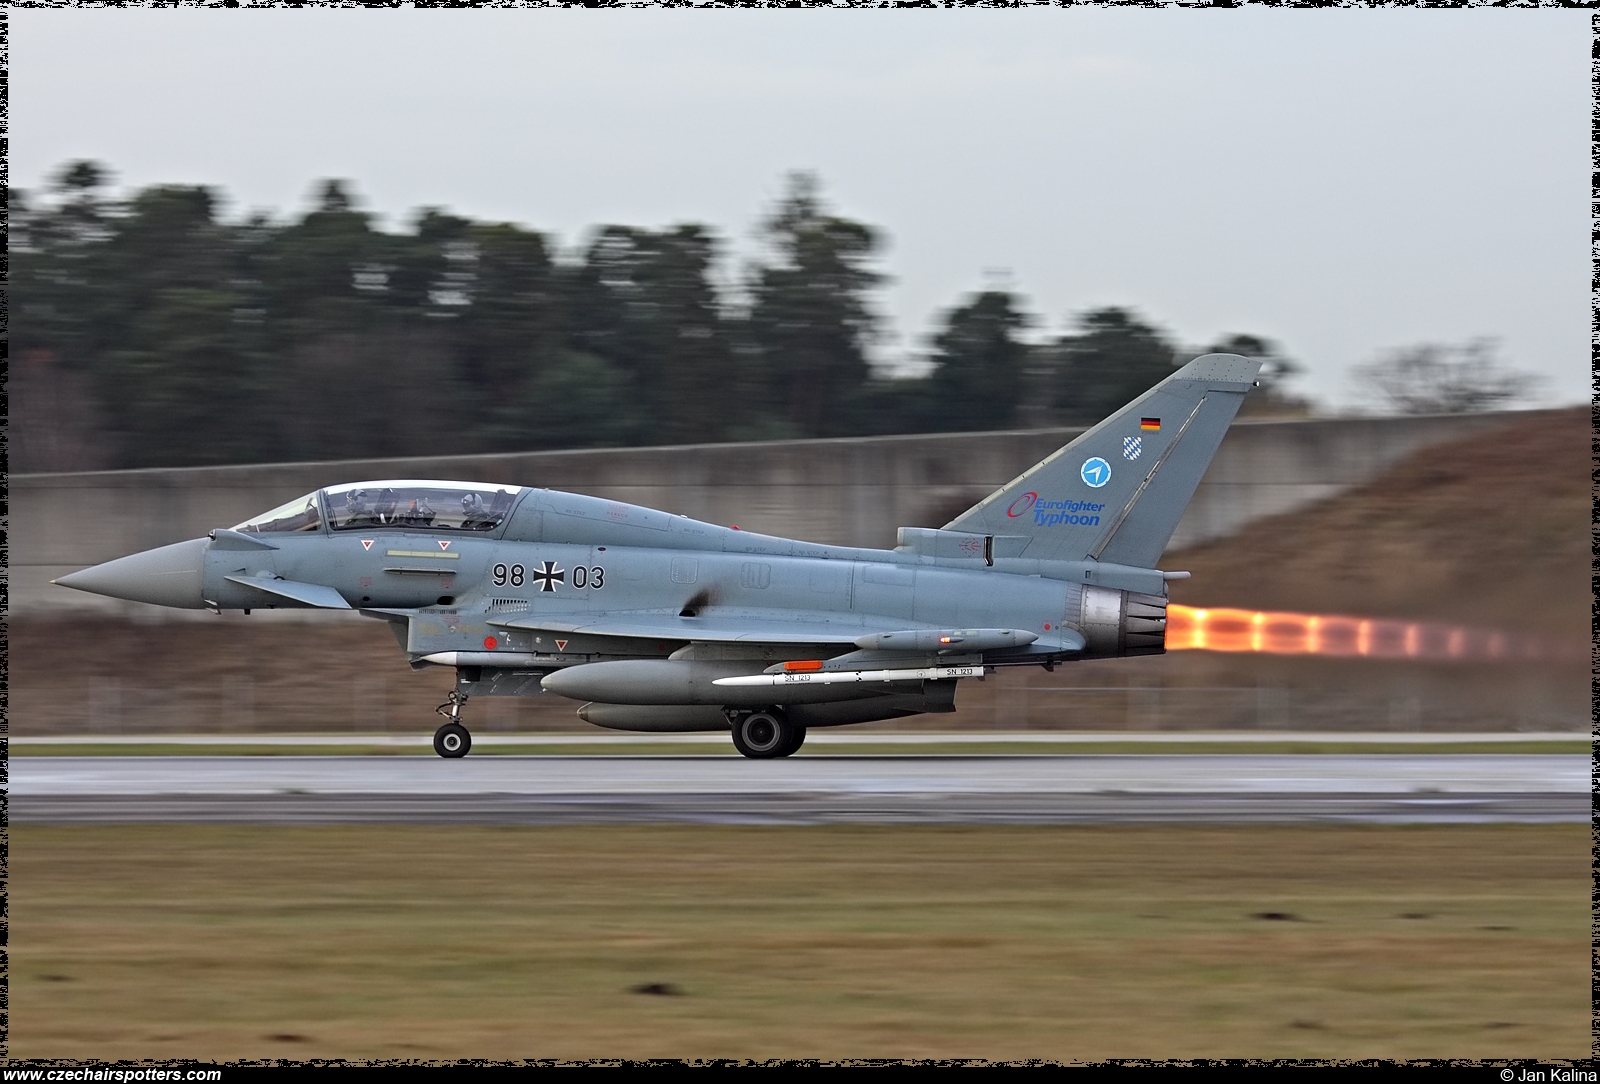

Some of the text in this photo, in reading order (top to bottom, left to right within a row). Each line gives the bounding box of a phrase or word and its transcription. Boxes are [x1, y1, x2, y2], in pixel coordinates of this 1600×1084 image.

[1035, 498, 1105, 513] Eurofighter
[1033, 509, 1101, 527] Typhoon
[491, 562, 606, 590] 98 03
[784, 674, 795, 682] SN
